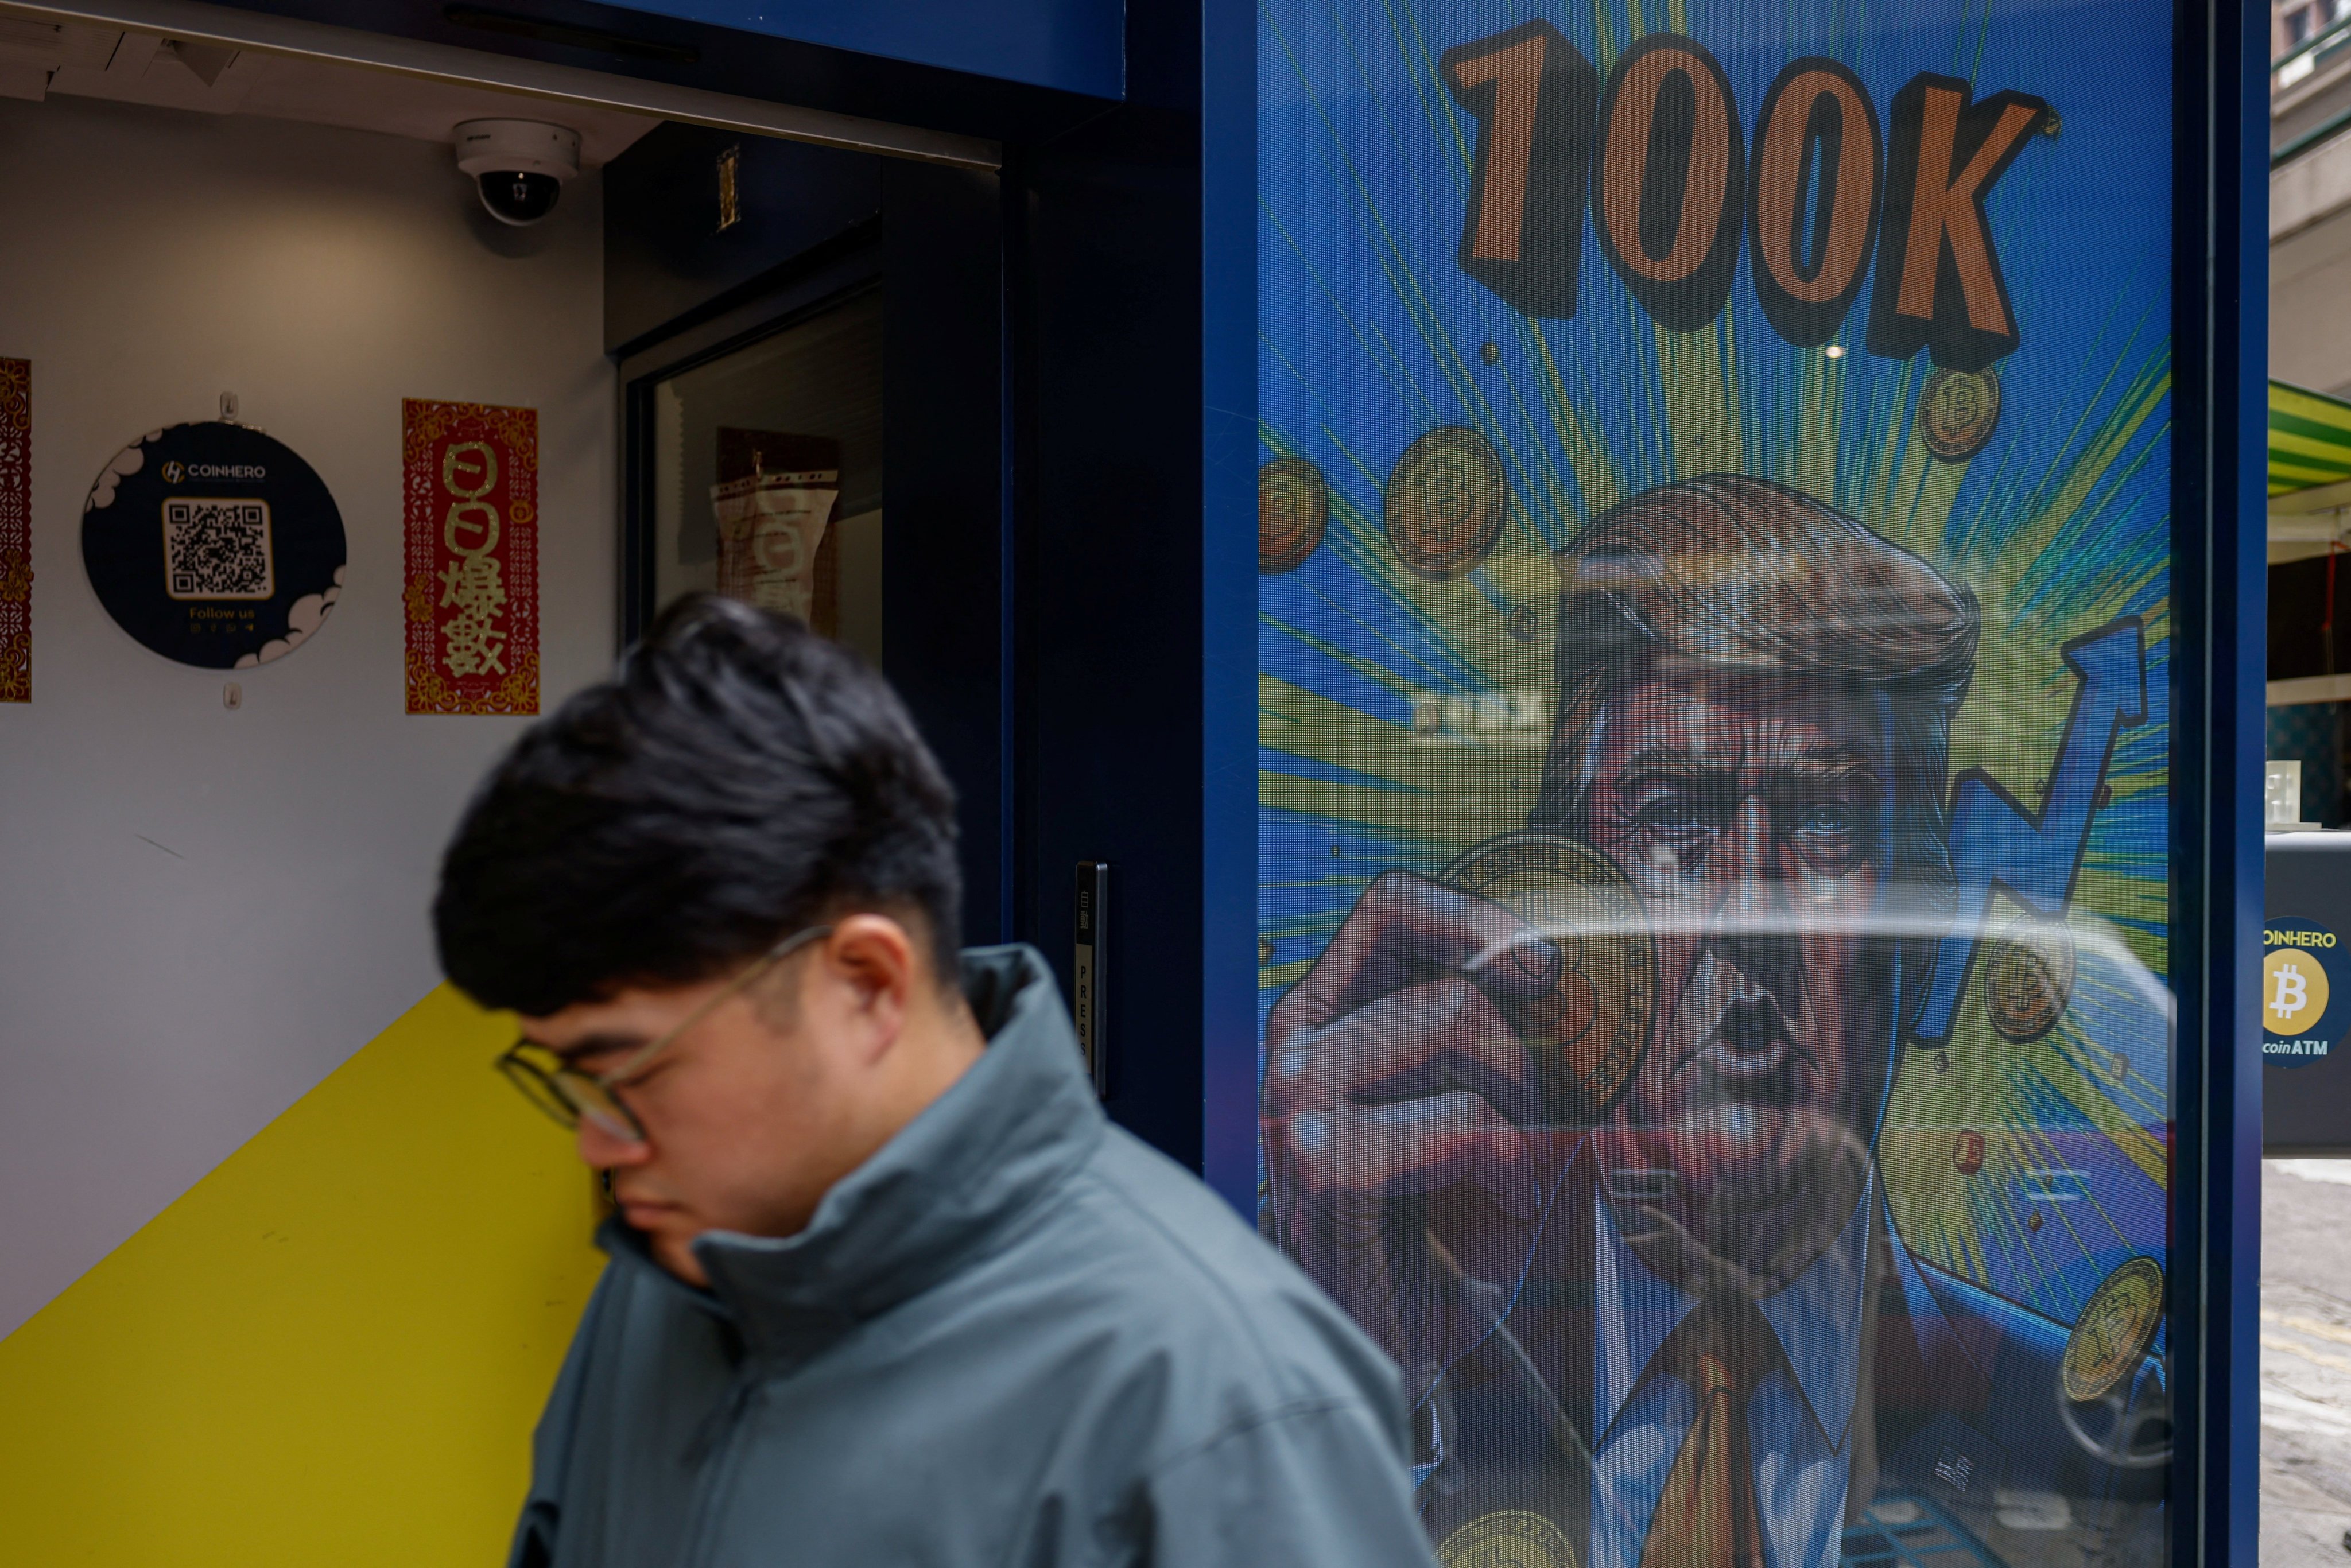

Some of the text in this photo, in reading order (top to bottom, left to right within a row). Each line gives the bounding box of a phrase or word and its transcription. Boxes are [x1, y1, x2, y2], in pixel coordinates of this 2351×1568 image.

[1441, 20, 2046, 367] 100K
[188, 463, 266, 479] COINHERO
[437, 441, 507, 678] 日日爆數
[189, 606, 255, 620] Follow us
[2263, 929, 2337, 948] OINHERO
[2262, 1039, 2328, 1055] coin ATM
